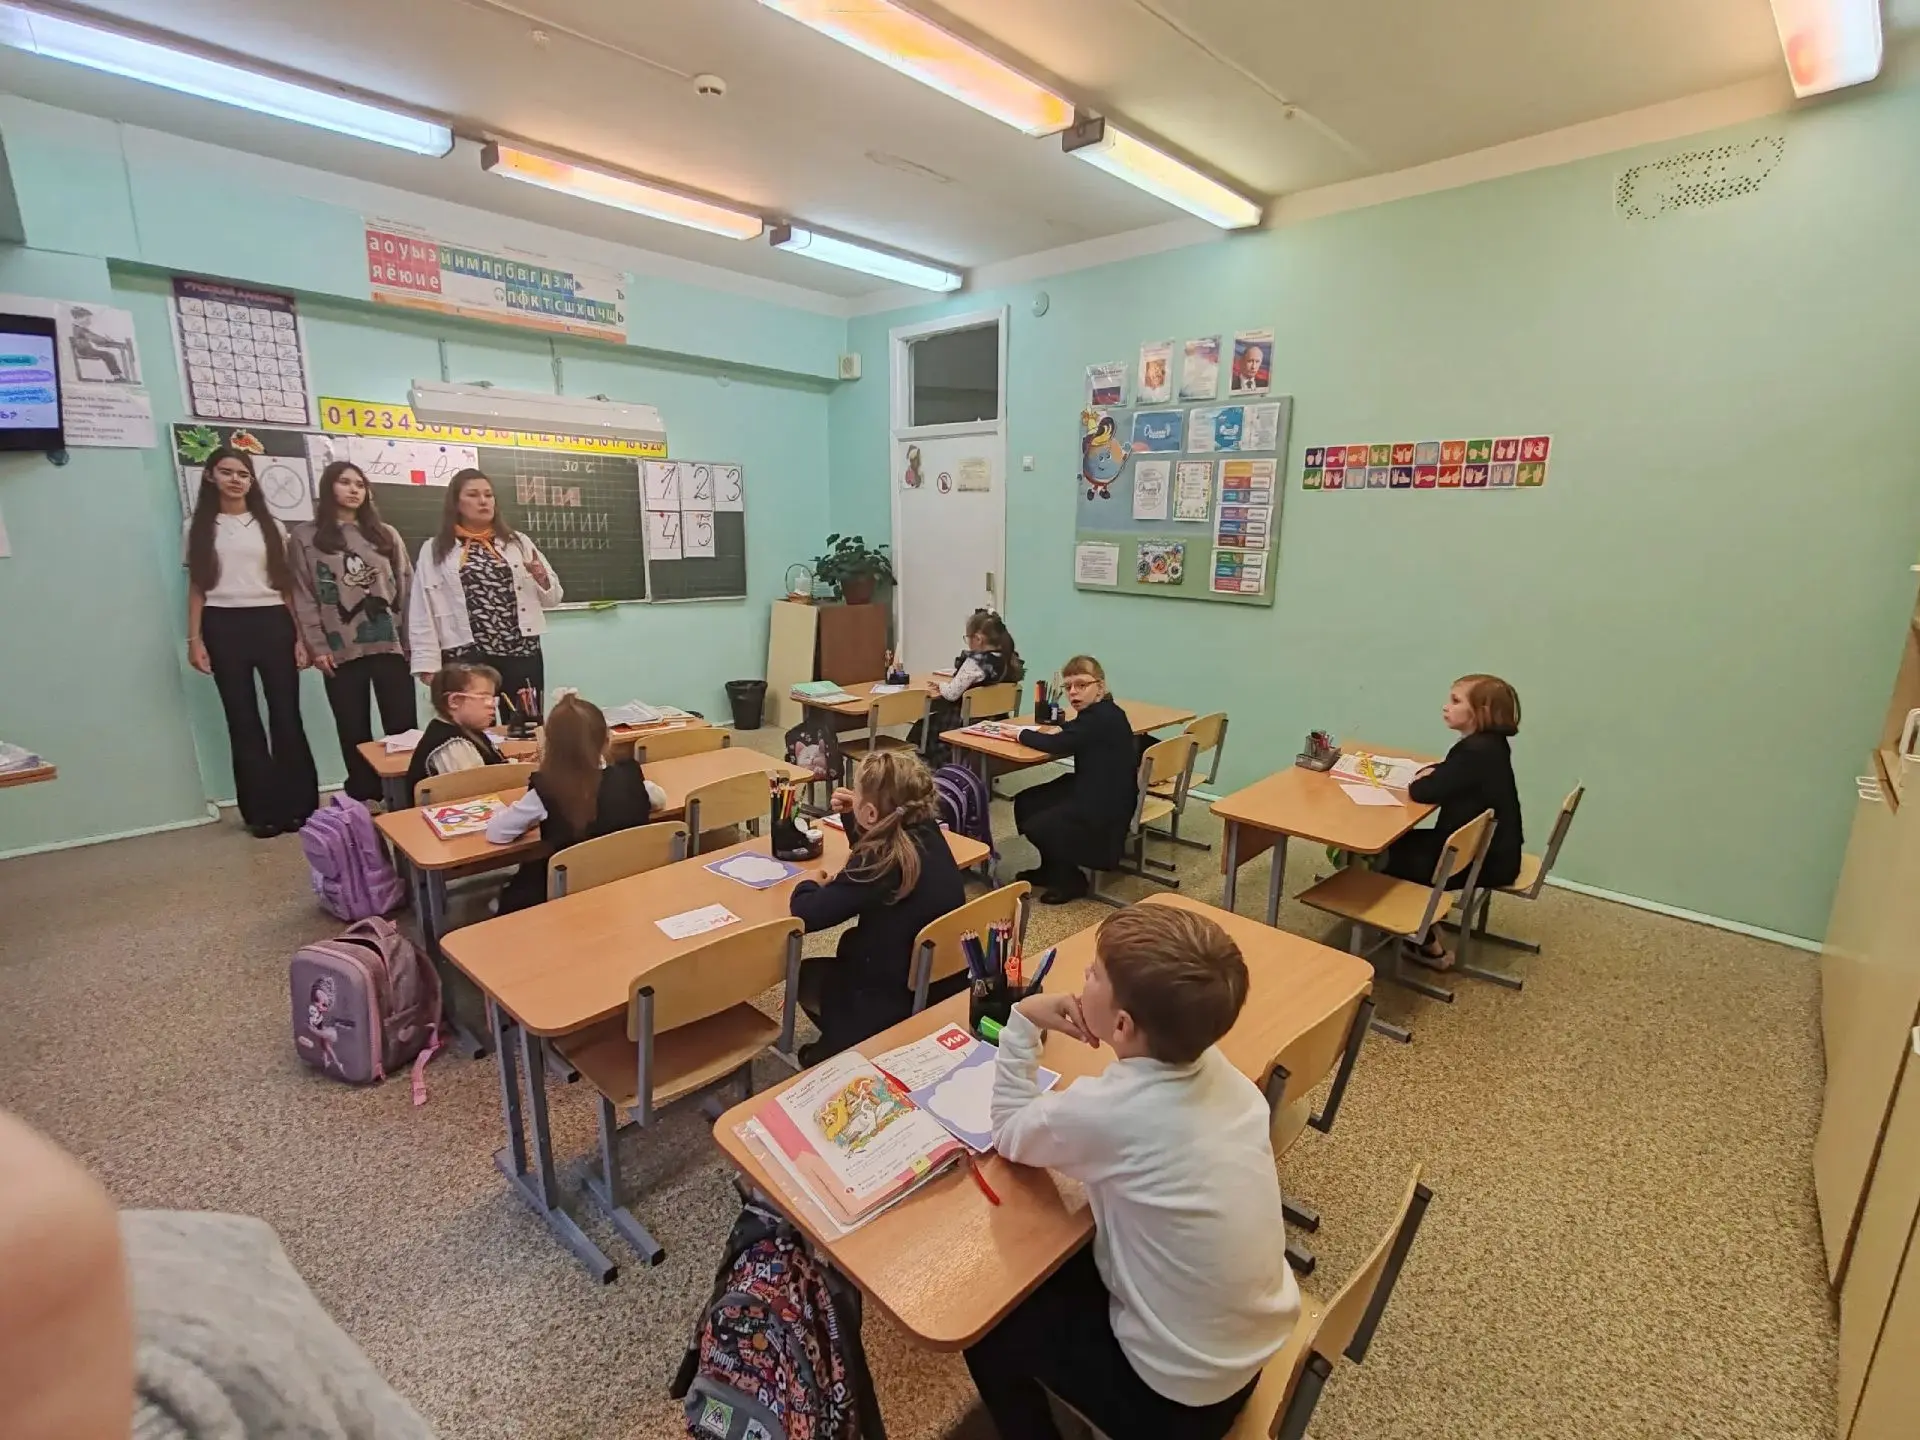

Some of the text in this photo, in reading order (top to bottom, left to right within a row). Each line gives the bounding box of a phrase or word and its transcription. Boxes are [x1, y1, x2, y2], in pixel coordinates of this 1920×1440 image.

[661, 466, 741, 501] 1 2 3
[662, 515, 678, 549] 4
